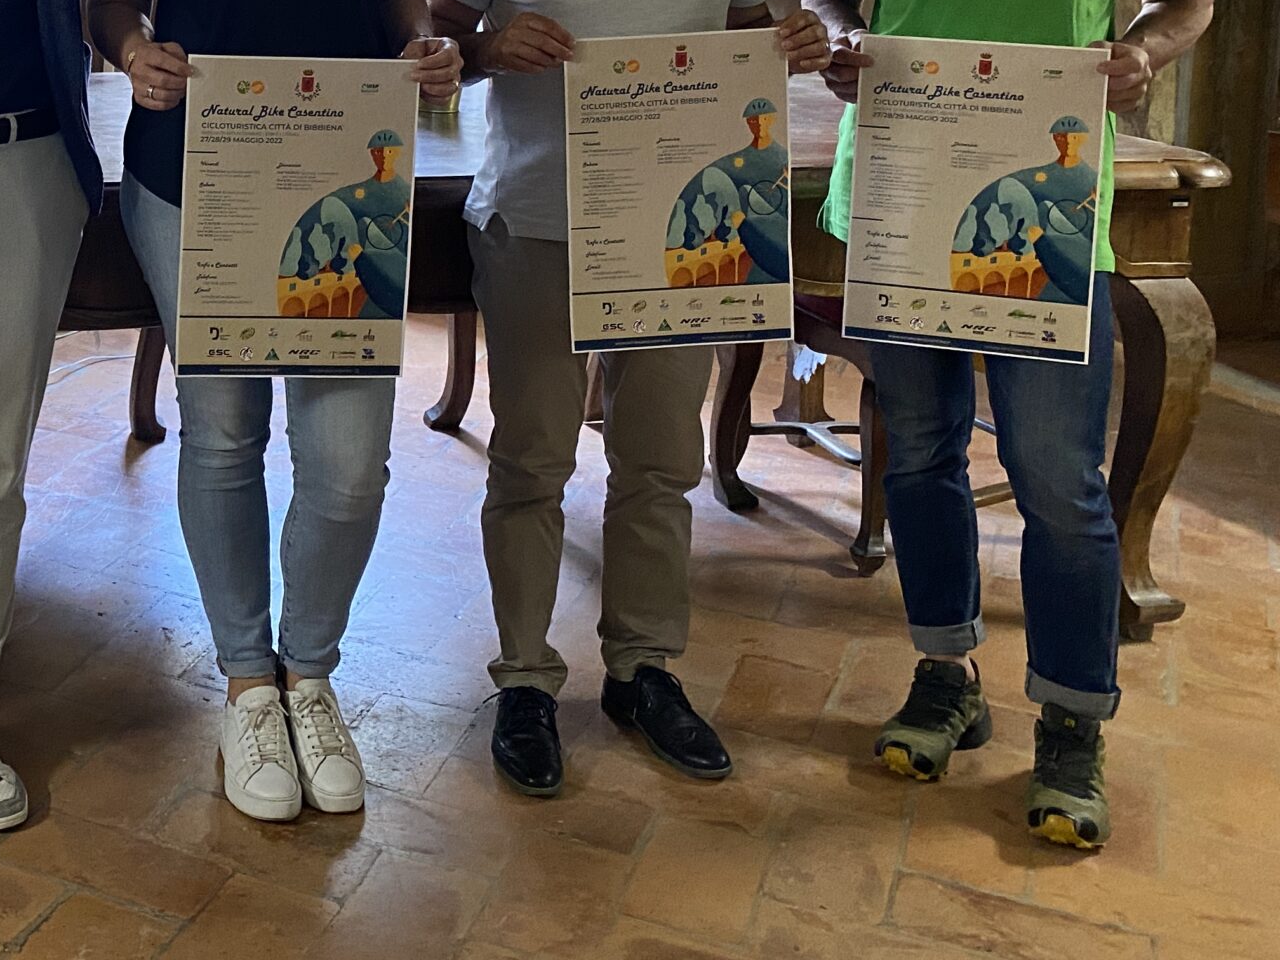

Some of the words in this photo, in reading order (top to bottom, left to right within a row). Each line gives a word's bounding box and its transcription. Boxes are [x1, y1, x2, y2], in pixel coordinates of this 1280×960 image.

[580, 84, 632, 100] Natural
[630, 82, 661, 100] Bike
[664, 81, 718, 94] Casentino
[874, 82, 929, 94] Natural
[927, 85, 960, 100] Bike
[963, 87, 1024, 101] Casentino
[581, 102, 644, 110] CICLOTURISTICA
[670, 98, 680, 106] DI
[680, 96, 718, 105] BIBBIENA
[874, 98, 942, 110] CICLOTURISTICA
[981, 106, 1023, 114] BIBBIENA
[202, 104, 255, 118] Natural
[253, 105, 285, 122] Bike
[288, 105, 344, 119] Casentino
[612, 114, 643, 122] MAGGIO
[906, 114, 939, 122] MAGGIO
[940, 116, 958, 124] 2022
[202, 122, 267, 130] CICLOTURISTICA
[304, 124, 343, 132] BIBBIENA
[232, 136, 264, 144] MAGGIO
